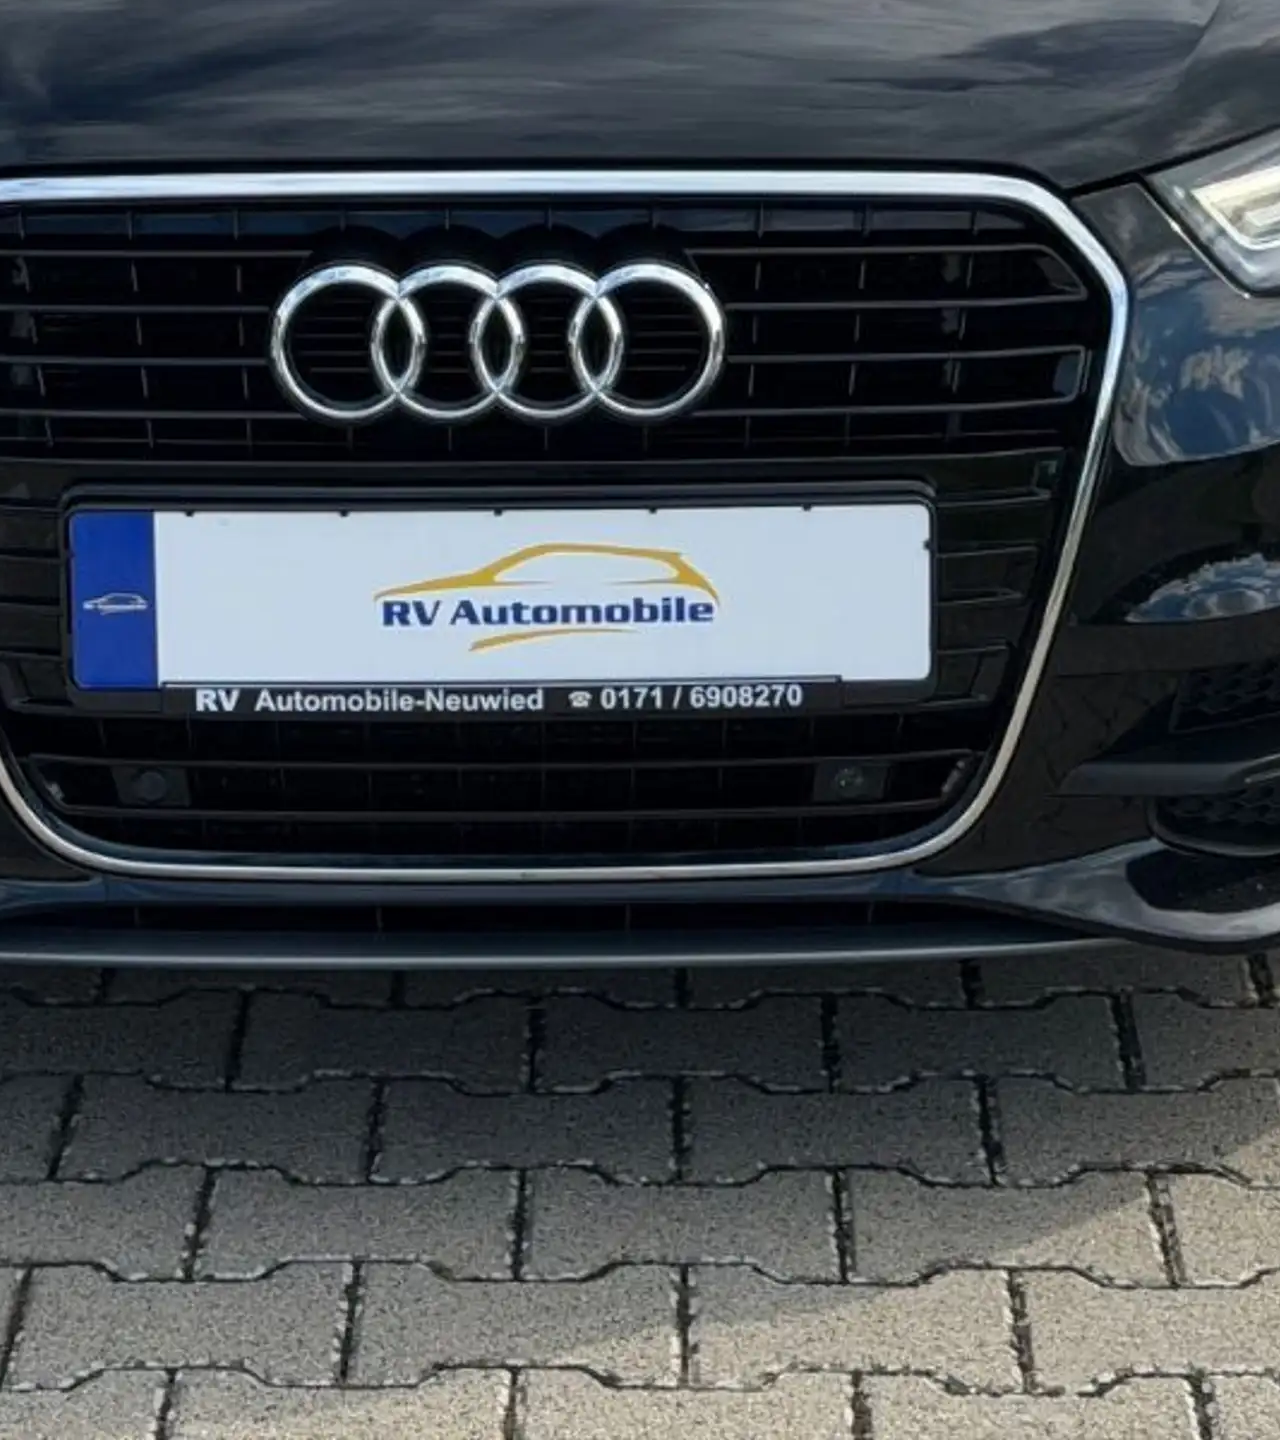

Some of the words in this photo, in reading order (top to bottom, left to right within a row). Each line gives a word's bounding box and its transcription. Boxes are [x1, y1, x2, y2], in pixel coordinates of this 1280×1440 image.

[382, 599, 441, 626] RV
[449, 597, 714, 626] Automobile
[195, 688, 240, 712] RV
[254, 687, 544, 712] Automobile-Neuwied
[600, 687, 663, 709] 0171
[689, 684, 803, 709] 6908270
